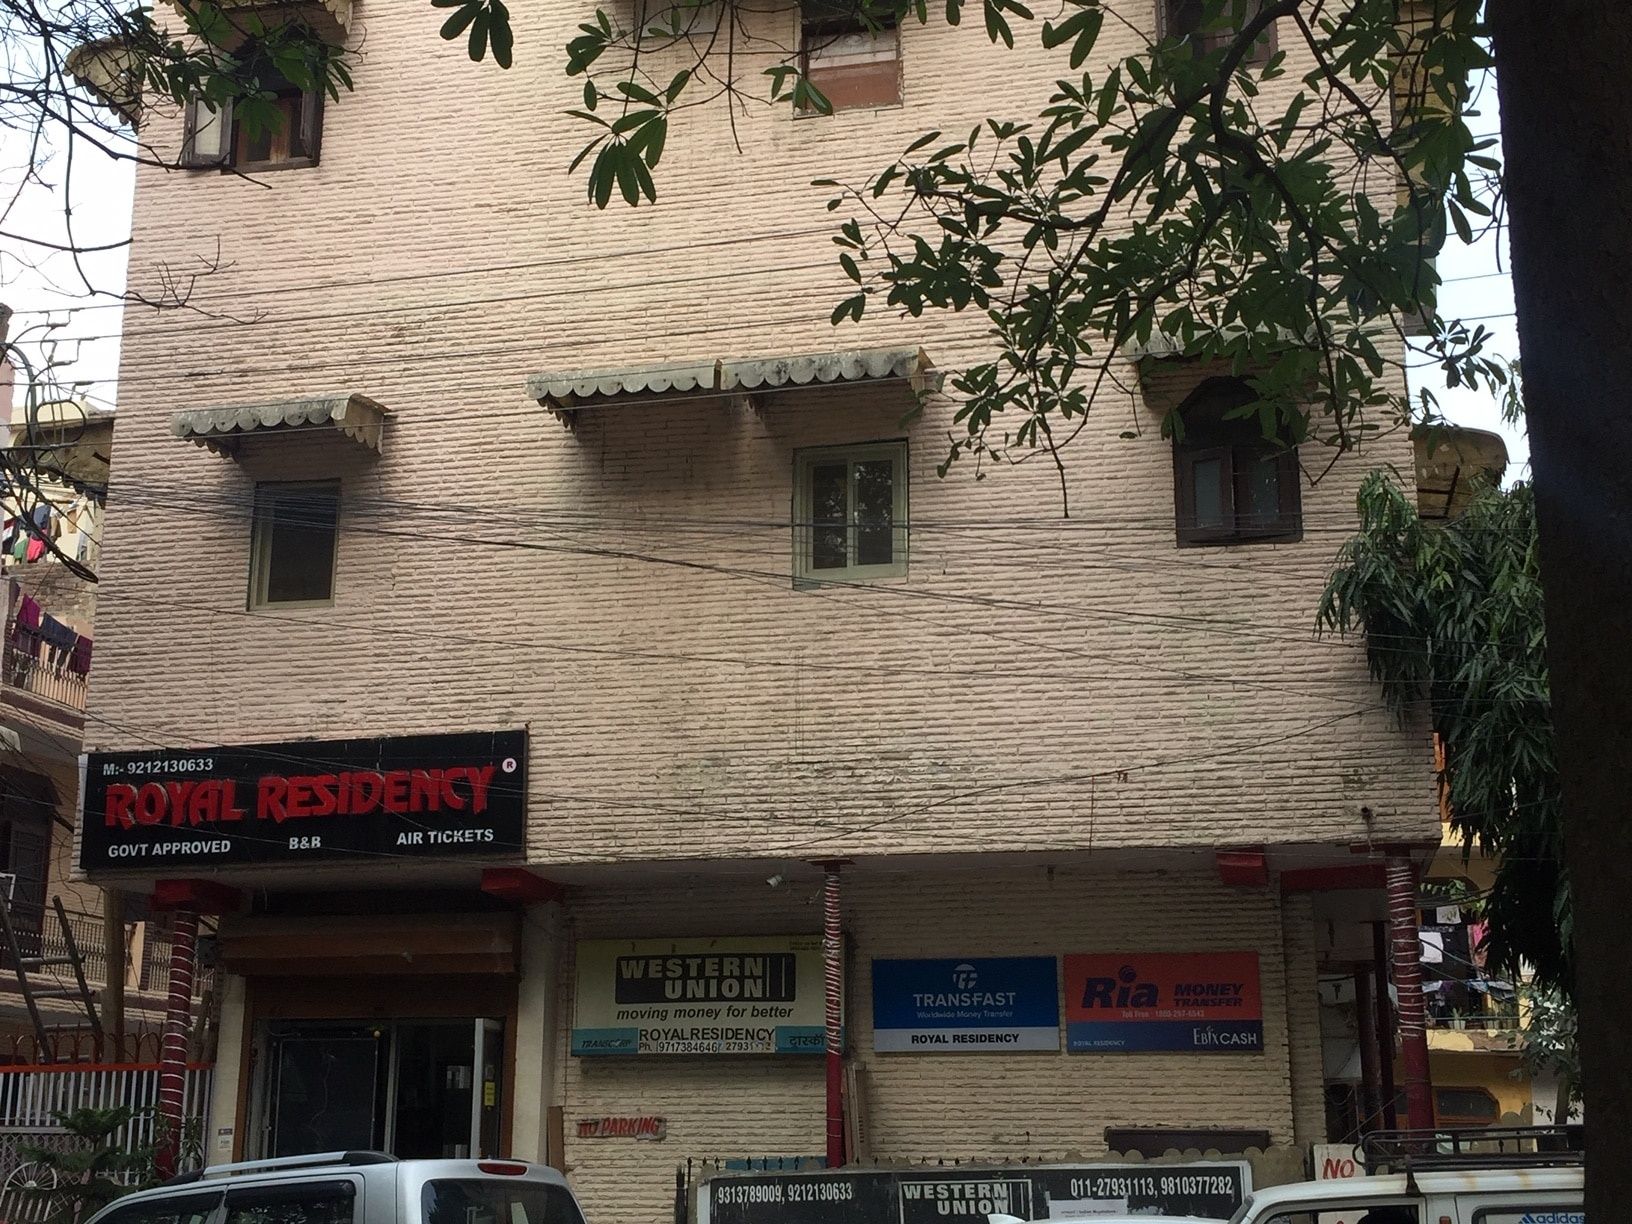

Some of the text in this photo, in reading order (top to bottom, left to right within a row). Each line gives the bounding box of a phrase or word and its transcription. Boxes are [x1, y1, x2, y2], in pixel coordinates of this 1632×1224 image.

[127, 759, 214, 774] 9212130633
[105, 779, 248, 830] ROYAL
[257, 763, 496, 824] RESIDENCY
[108, 829, 494, 858] GOVT APPROVED B&B AIR TICKETS
[621, 957, 763, 979] WESTERN
[664, 978, 763, 999] UNION
[1081, 965, 1244, 1008] Ria MONEY
[913, 992, 1016, 1007] TRANSFAST
[1173, 997, 1243, 1007] TRANSFER
[616, 1005, 793, 1020] moving money for better
[956, 1010, 982, 1019] Money
[984, 1009, 1014, 1017] Transfer
[639, 1028, 775, 1041] ROYALRESIDENCY
[911, 1033, 1019, 1044] ROYAL RESIDENCY
[602, 1117, 660, 1136] PARKING
[1323, 1158, 1354, 1180] NO
[718, 1182, 852, 1204] 9313789009, 9212130633
[903, 1183, 1008, 1199] WESTERN
[1161, 1176, 1232, 1195] 9810377282
[937, 1199, 1008, 1215] UNION
